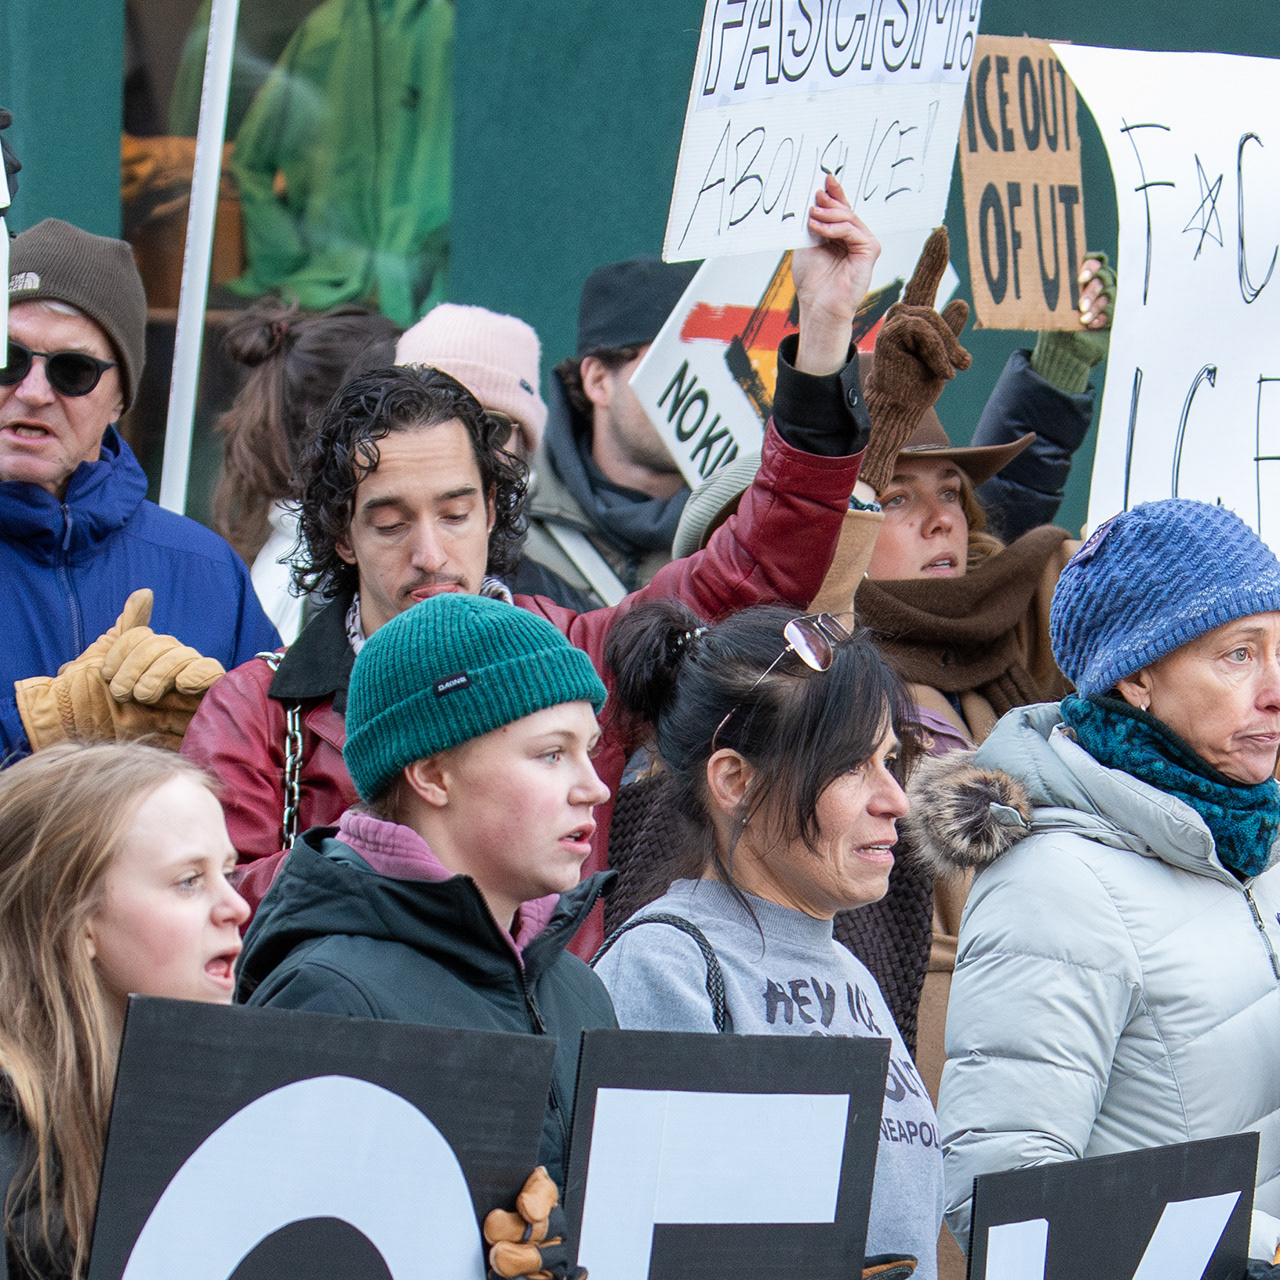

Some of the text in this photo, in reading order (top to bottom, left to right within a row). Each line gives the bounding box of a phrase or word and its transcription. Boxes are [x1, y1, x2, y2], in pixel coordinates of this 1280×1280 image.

[703, 0, 978, 96] FASCISM!
[1018, 55, 1072, 153] OUT
[979, 181, 1081, 312] OF UT
[657, 358, 709, 442] NO
[762, 976, 883, 1036] HEY ICE
